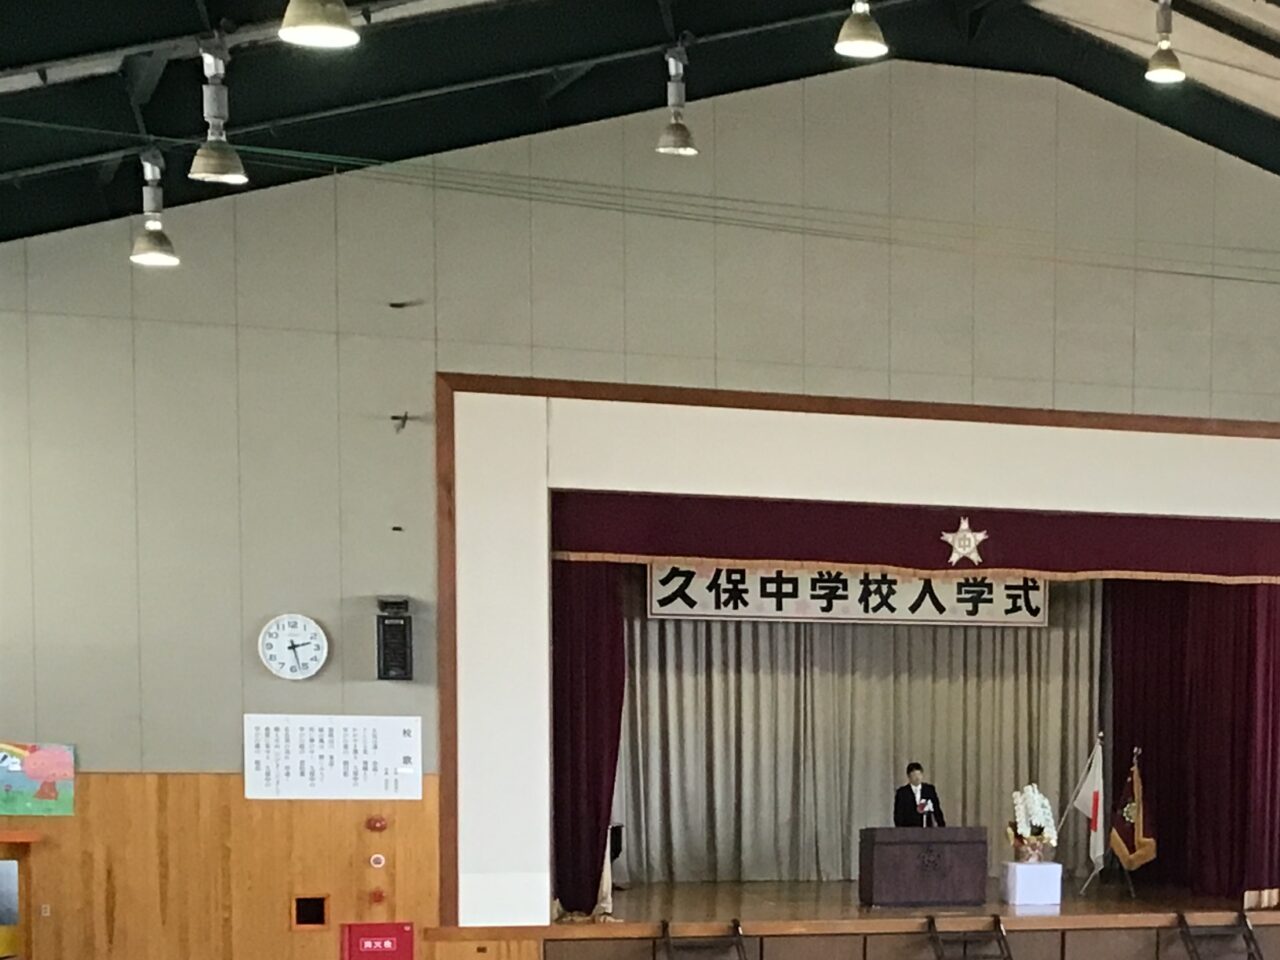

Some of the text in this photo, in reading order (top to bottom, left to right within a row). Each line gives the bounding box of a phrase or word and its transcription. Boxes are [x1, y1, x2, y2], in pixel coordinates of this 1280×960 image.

[657, 566, 1041, 618] 久保中学校入学式
